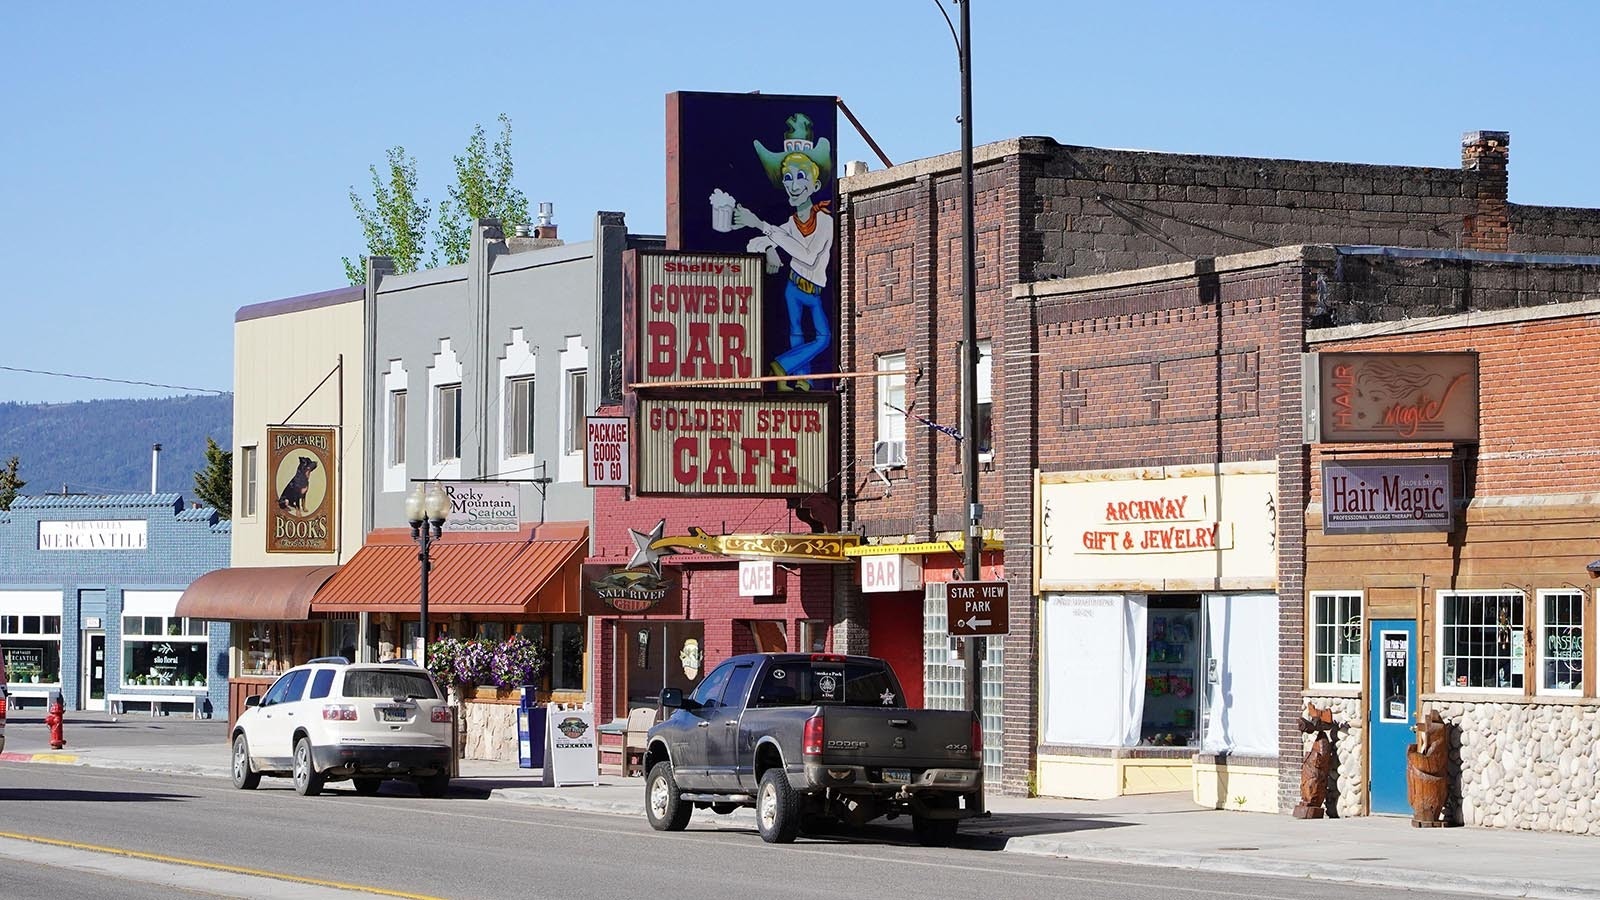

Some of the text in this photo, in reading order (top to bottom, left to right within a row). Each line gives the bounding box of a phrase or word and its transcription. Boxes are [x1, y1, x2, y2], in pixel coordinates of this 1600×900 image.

[664, 261, 741, 274] Shelly's
[650, 284, 752, 314] COWBOY
[647, 321, 752, 378] BAR
[650, 408, 821, 433] GOLDEN SPUR
[589, 424, 627, 442] PACKAGE
[593, 443, 621, 461] GOODS
[673, 437, 797, 485] CAFE
[593, 463, 622, 480] TO GO
[445, 486, 484, 501] Rocky
[1332, 474, 1444, 520] Hair Magic
[450, 496, 511, 513] Mountain
[468, 505, 516, 522] Seafood
[1105, 495, 1188, 521] ARCHWAY
[276, 516, 327, 539] BOOKS
[1082, 522, 1220, 551] GIFT & JEWELRY
[42, 533, 147, 548] MERCANTILE
[742, 565, 772, 590] CAFE
[866, 561, 895, 586] BAR
[598, 589, 665, 599] SALT RIVER
[951, 587, 1005, 598] STAR VIEW
[965, 601, 991, 612] PARK
